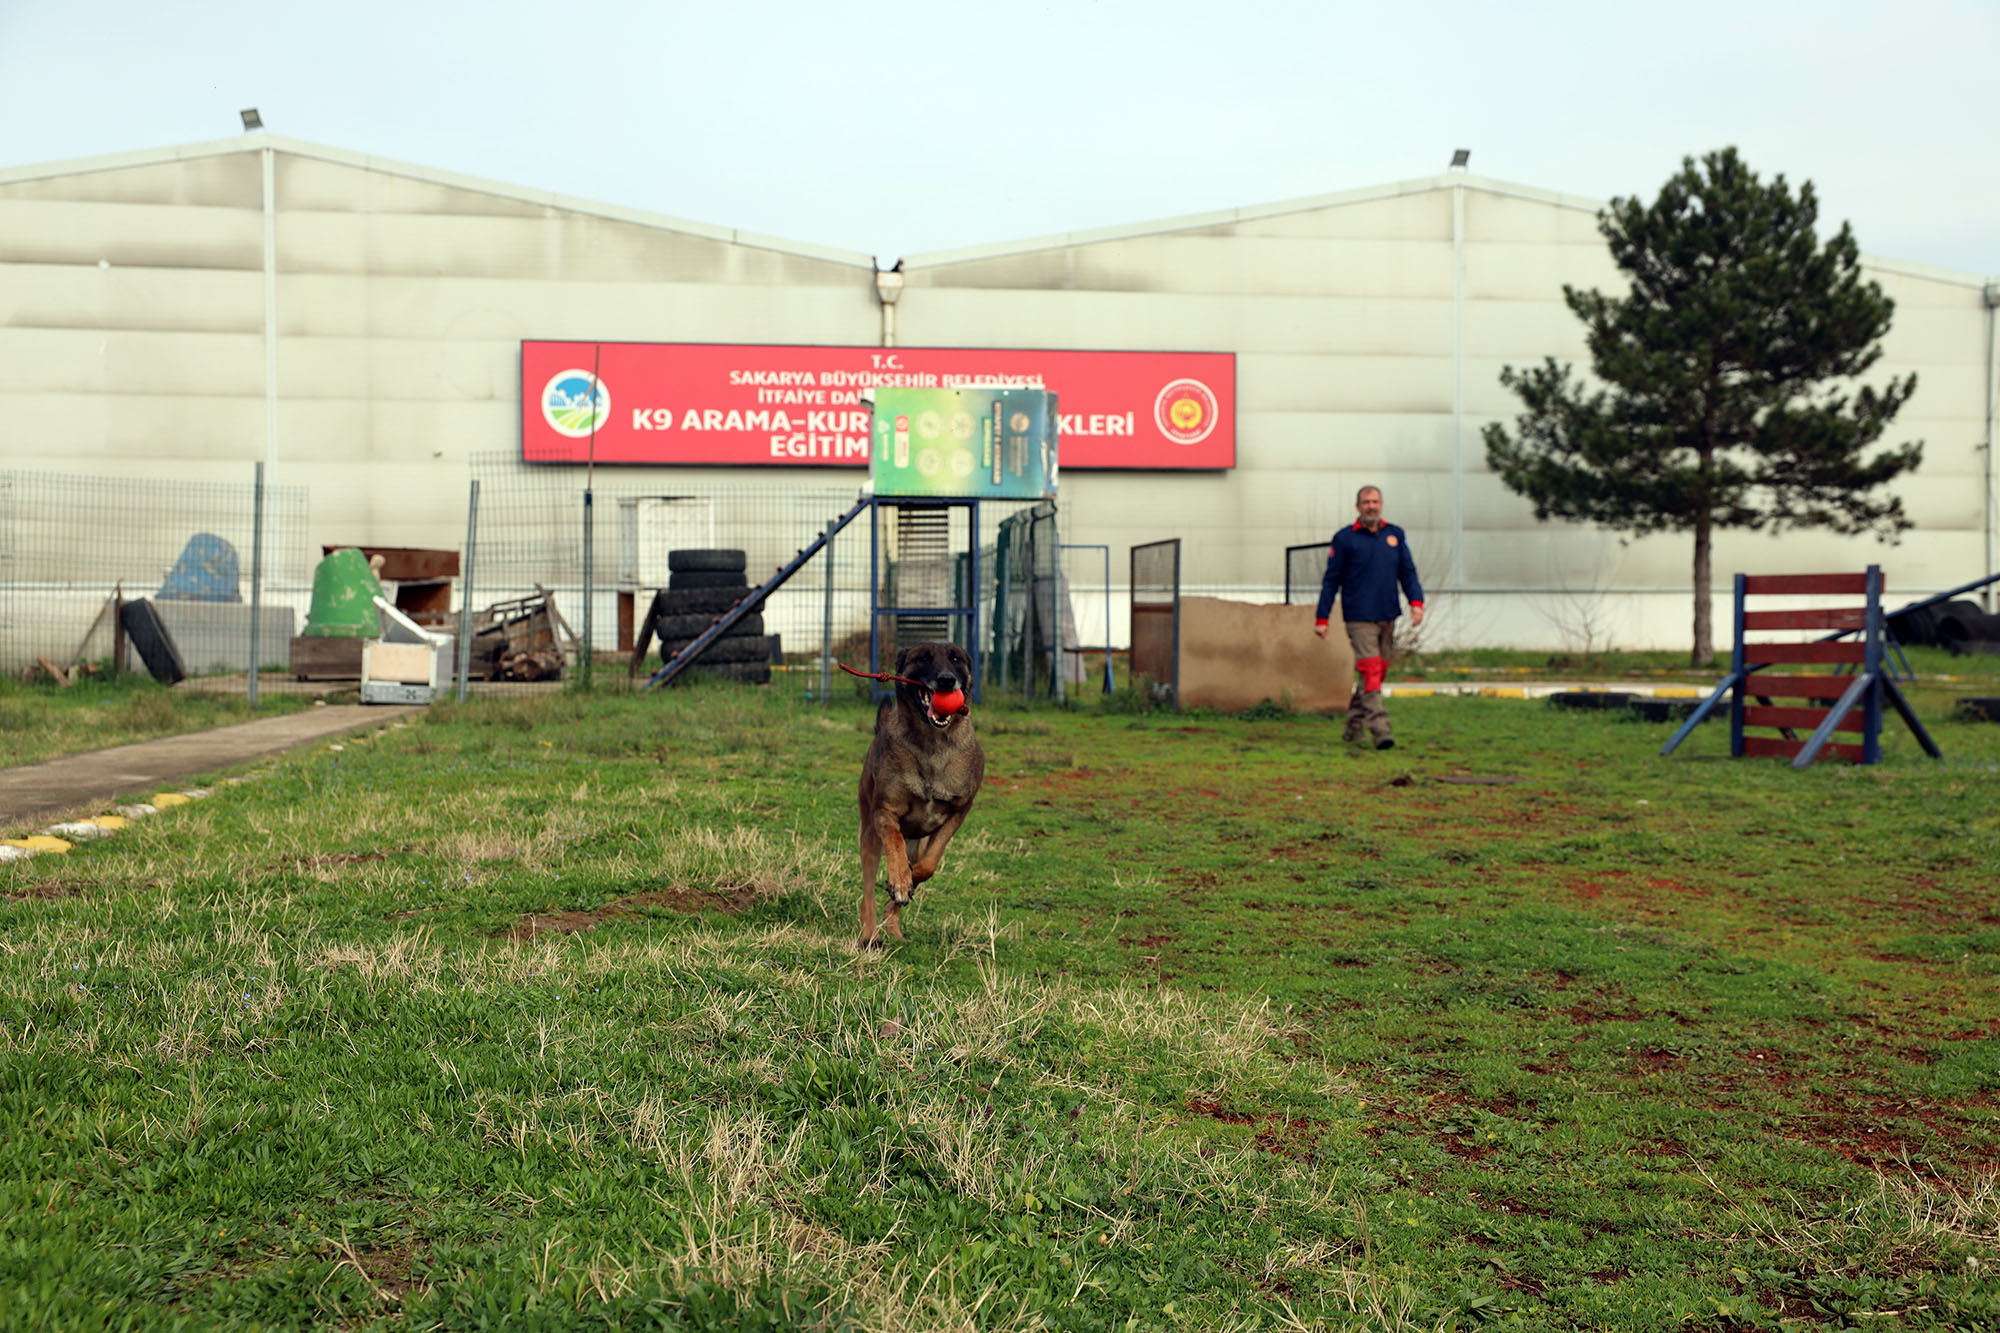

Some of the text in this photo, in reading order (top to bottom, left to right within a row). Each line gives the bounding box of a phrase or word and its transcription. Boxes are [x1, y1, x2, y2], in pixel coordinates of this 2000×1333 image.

[871, 354, 904, 370] T.C.
[729, 370, 816, 386] SAKARYA
[758, 387, 826, 405] İTFAİYE
[632, 408, 1135, 436] K9 ARAMA-KUR KLERİ
[770, 432, 869, 457] EĞİTİM
